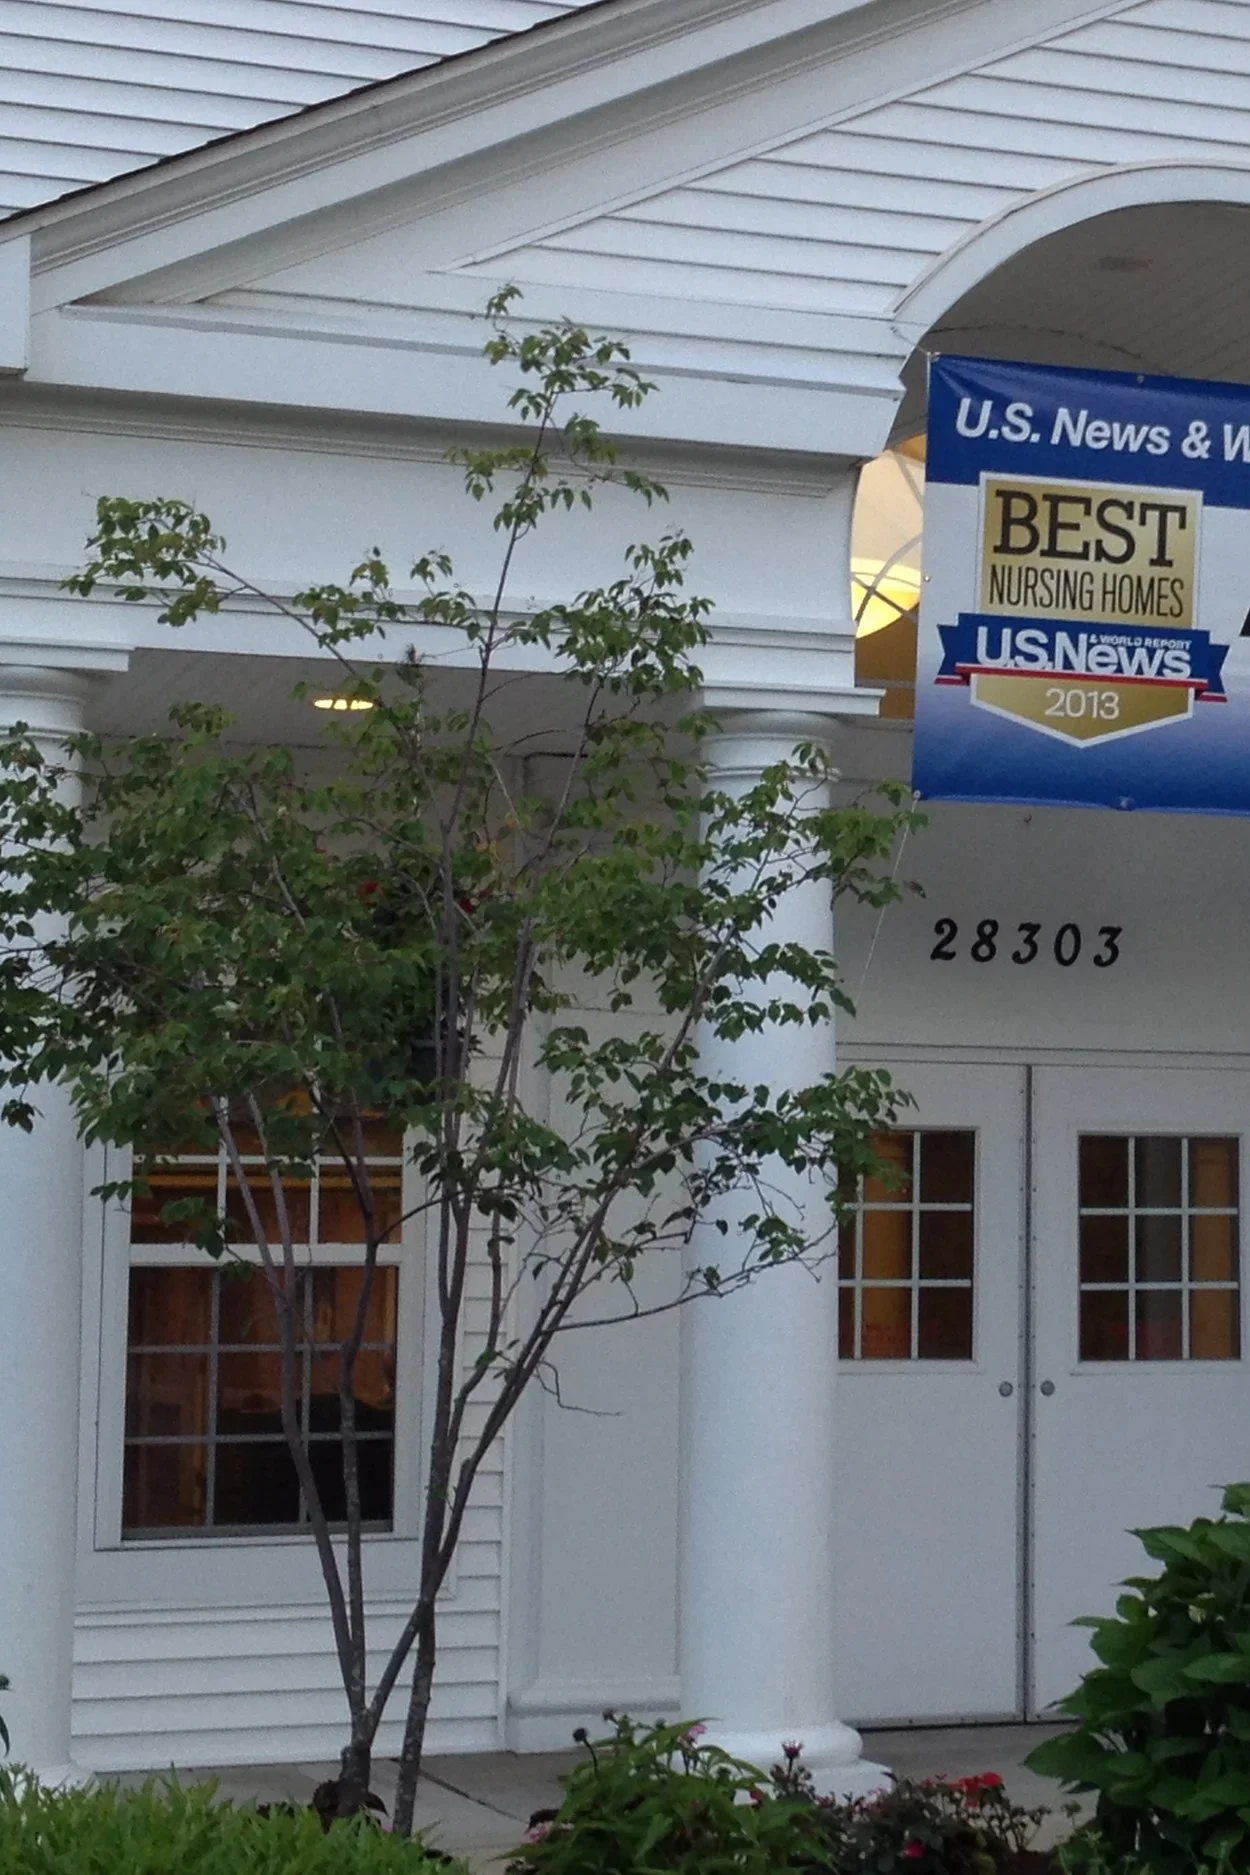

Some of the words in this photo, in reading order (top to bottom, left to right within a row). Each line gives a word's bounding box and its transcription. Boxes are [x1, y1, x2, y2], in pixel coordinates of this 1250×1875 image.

[954, 398, 1040, 445] U.S.
[1050, 408, 1171, 456] News
[1180, 423, 1211, 458] &
[993, 489, 1187, 568] BEST
[988, 563, 1095, 614] NURSING
[1101, 573, 1184, 618] HOMES
[1099, 635, 1142, 648] WORLD
[1144, 637, 1192, 650] REPORT
[1044, 688, 1120, 720] 2013
[929, 917, 1123, 968] 28303
